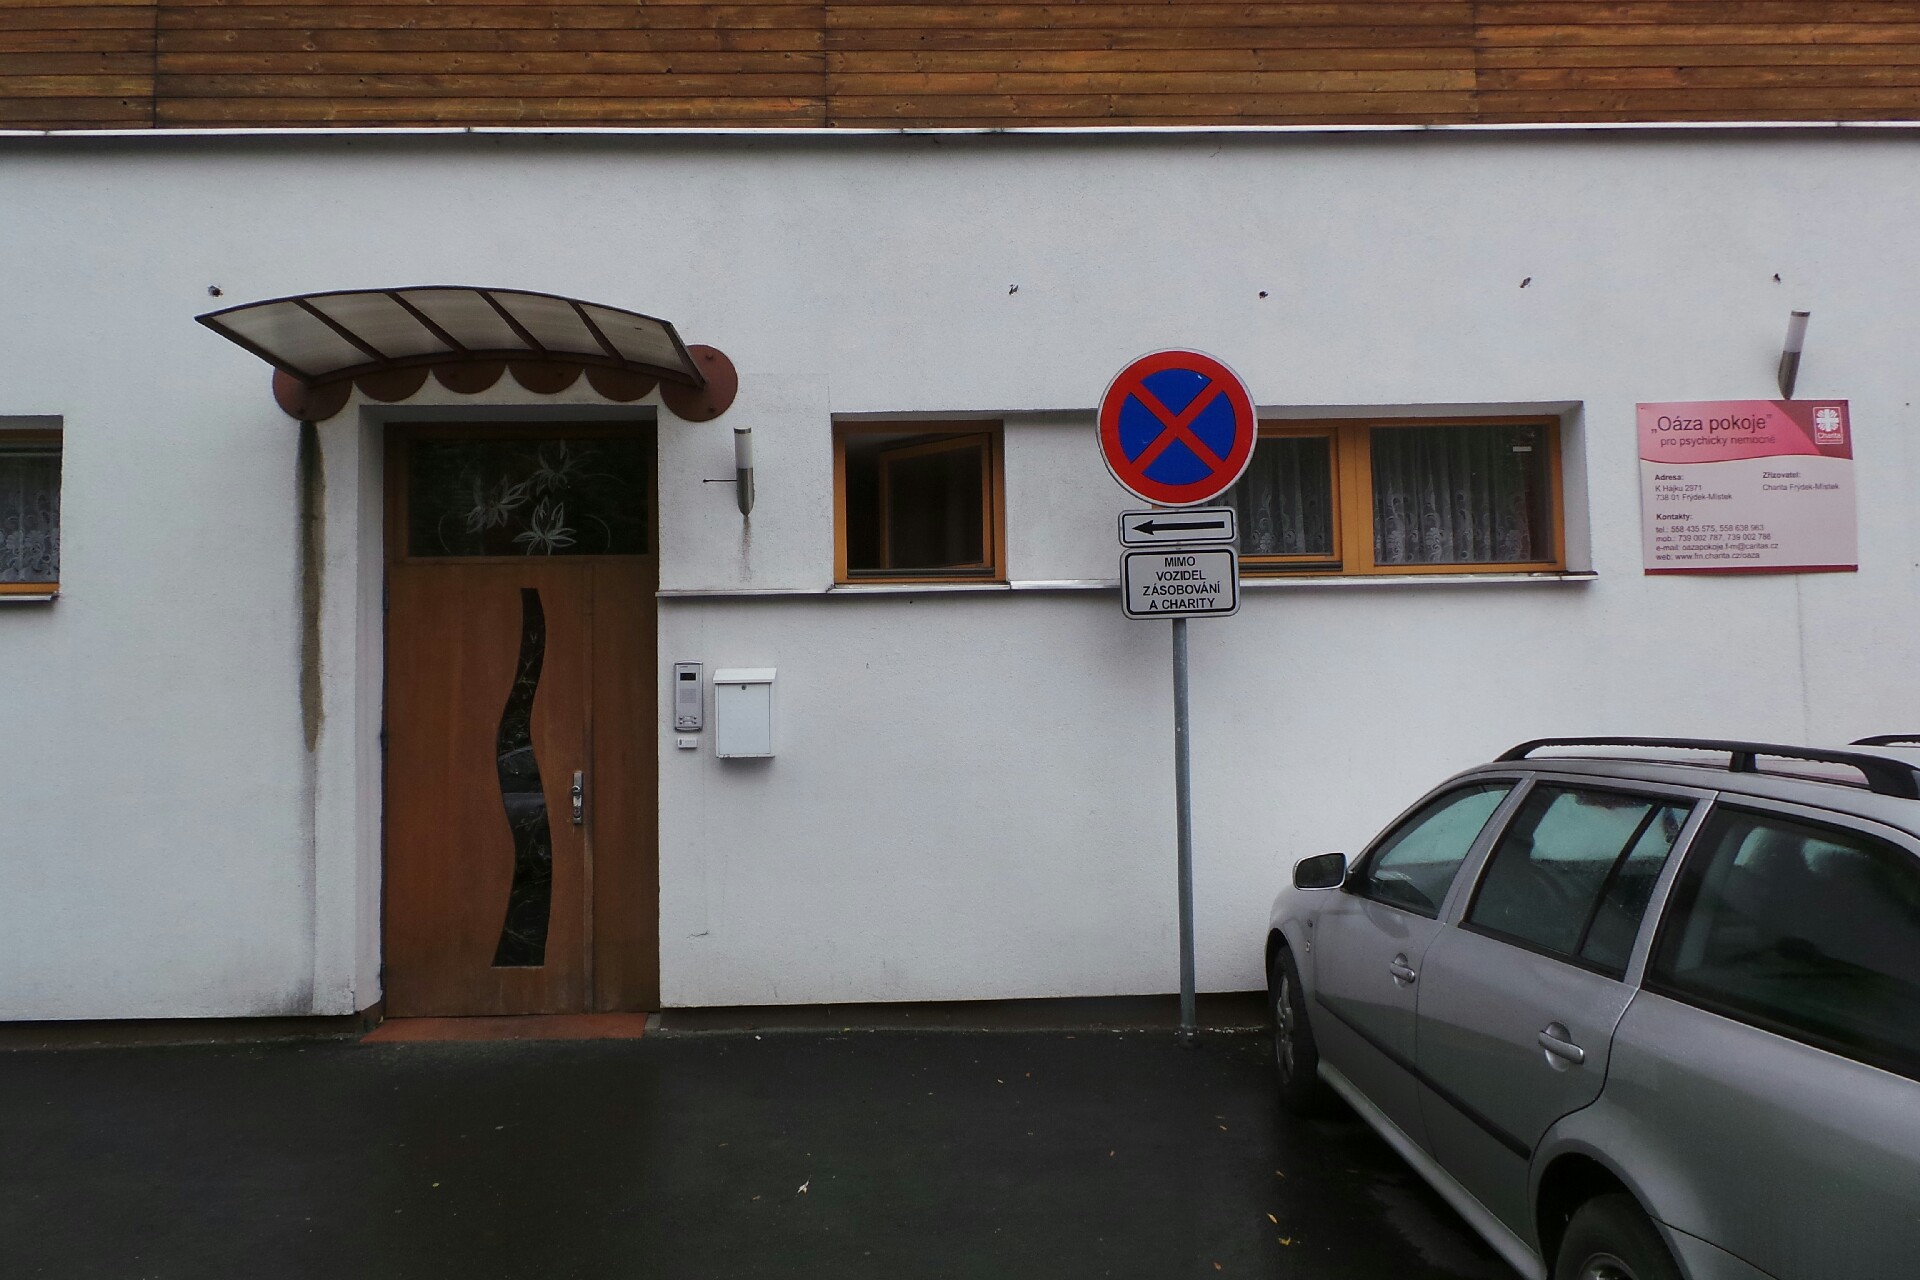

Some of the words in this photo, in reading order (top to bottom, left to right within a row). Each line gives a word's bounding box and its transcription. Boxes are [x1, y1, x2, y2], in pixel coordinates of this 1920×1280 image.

[1660, 437, 1676, 447] pro
[1762, 483, 1788, 491] Charita
[1656, 513, 1694, 521] Kontakty:
[1671, 525, 1685, 533] 558
[1719, 524, 1733, 532] 558
[1742, 533, 1756, 541] 002
[1164, 556, 1196, 567] MIMO
[1655, 553, 1673, 561] web:
[1156, 570, 1206, 581] VOZIDEL
[1142, 580, 1221, 596] ZÁSOBOVÁNÍ
[1149, 600, 1159, 611] A
[1161, 597, 1216, 610] CHARITY
